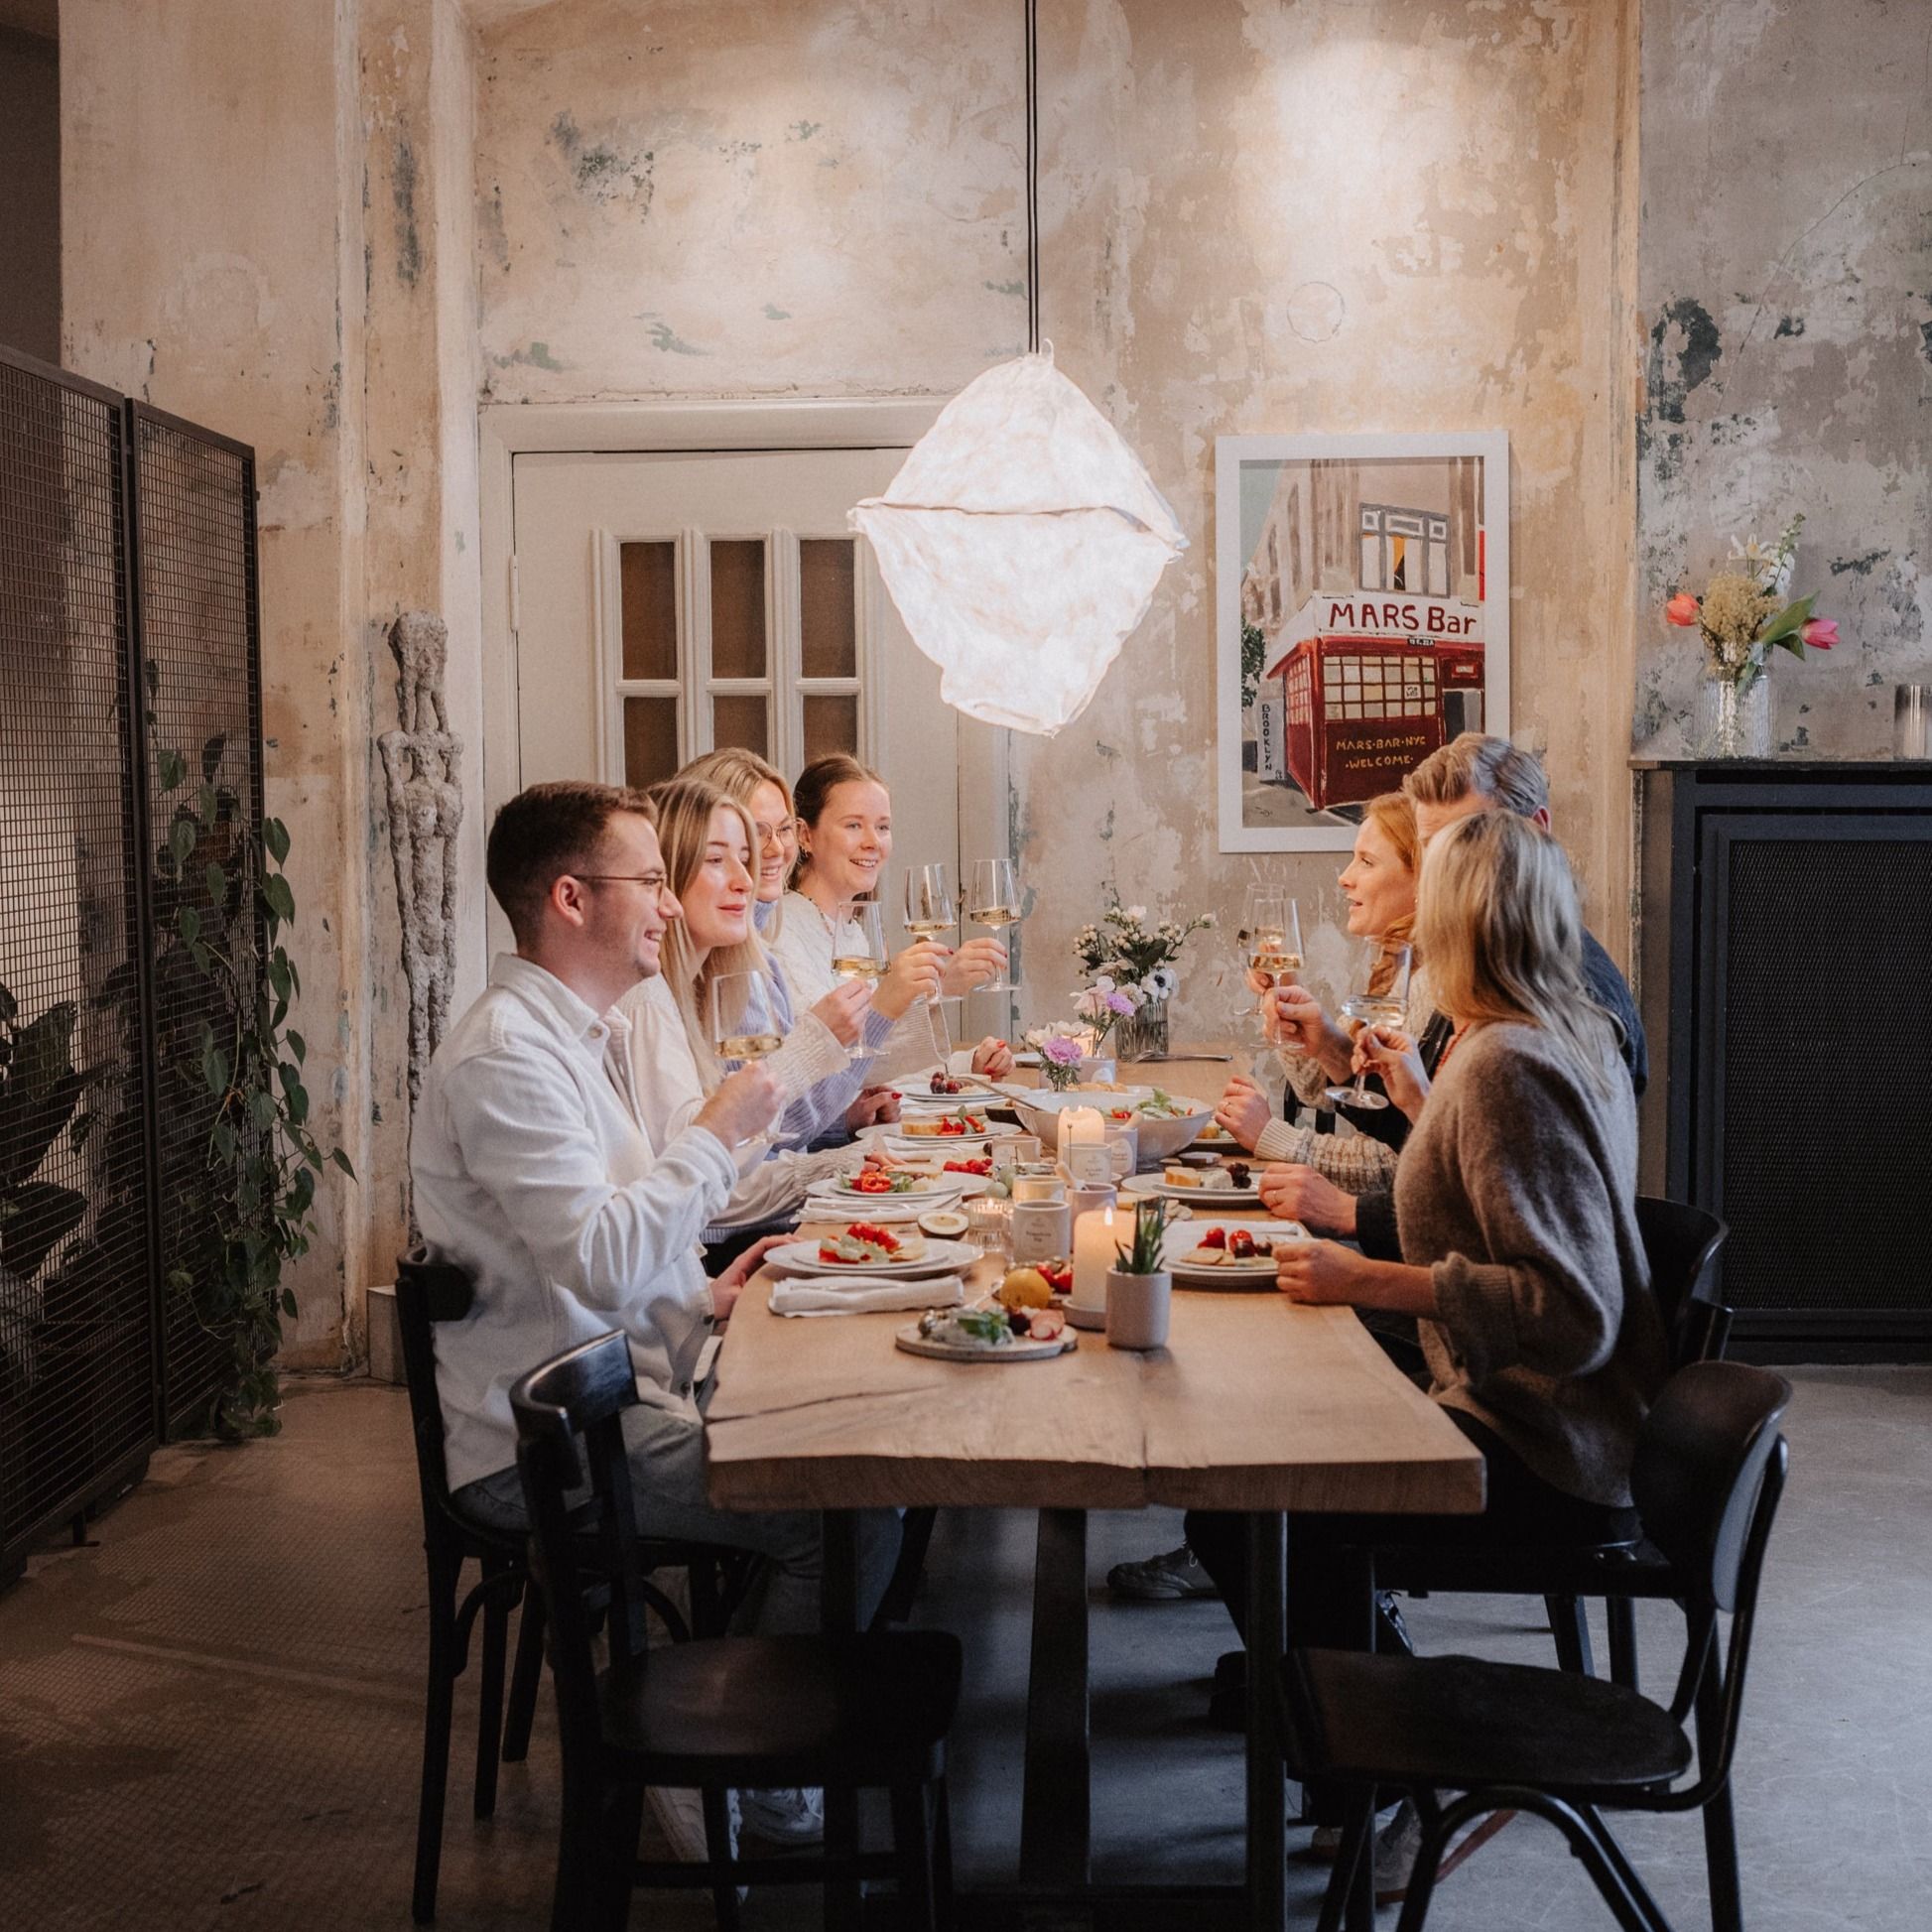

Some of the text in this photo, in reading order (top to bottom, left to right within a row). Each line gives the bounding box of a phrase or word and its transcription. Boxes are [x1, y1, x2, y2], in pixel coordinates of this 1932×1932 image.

[1329, 602, 1478, 635] MARS Bar
[1261, 704, 1272, 771] BROOKLYN
